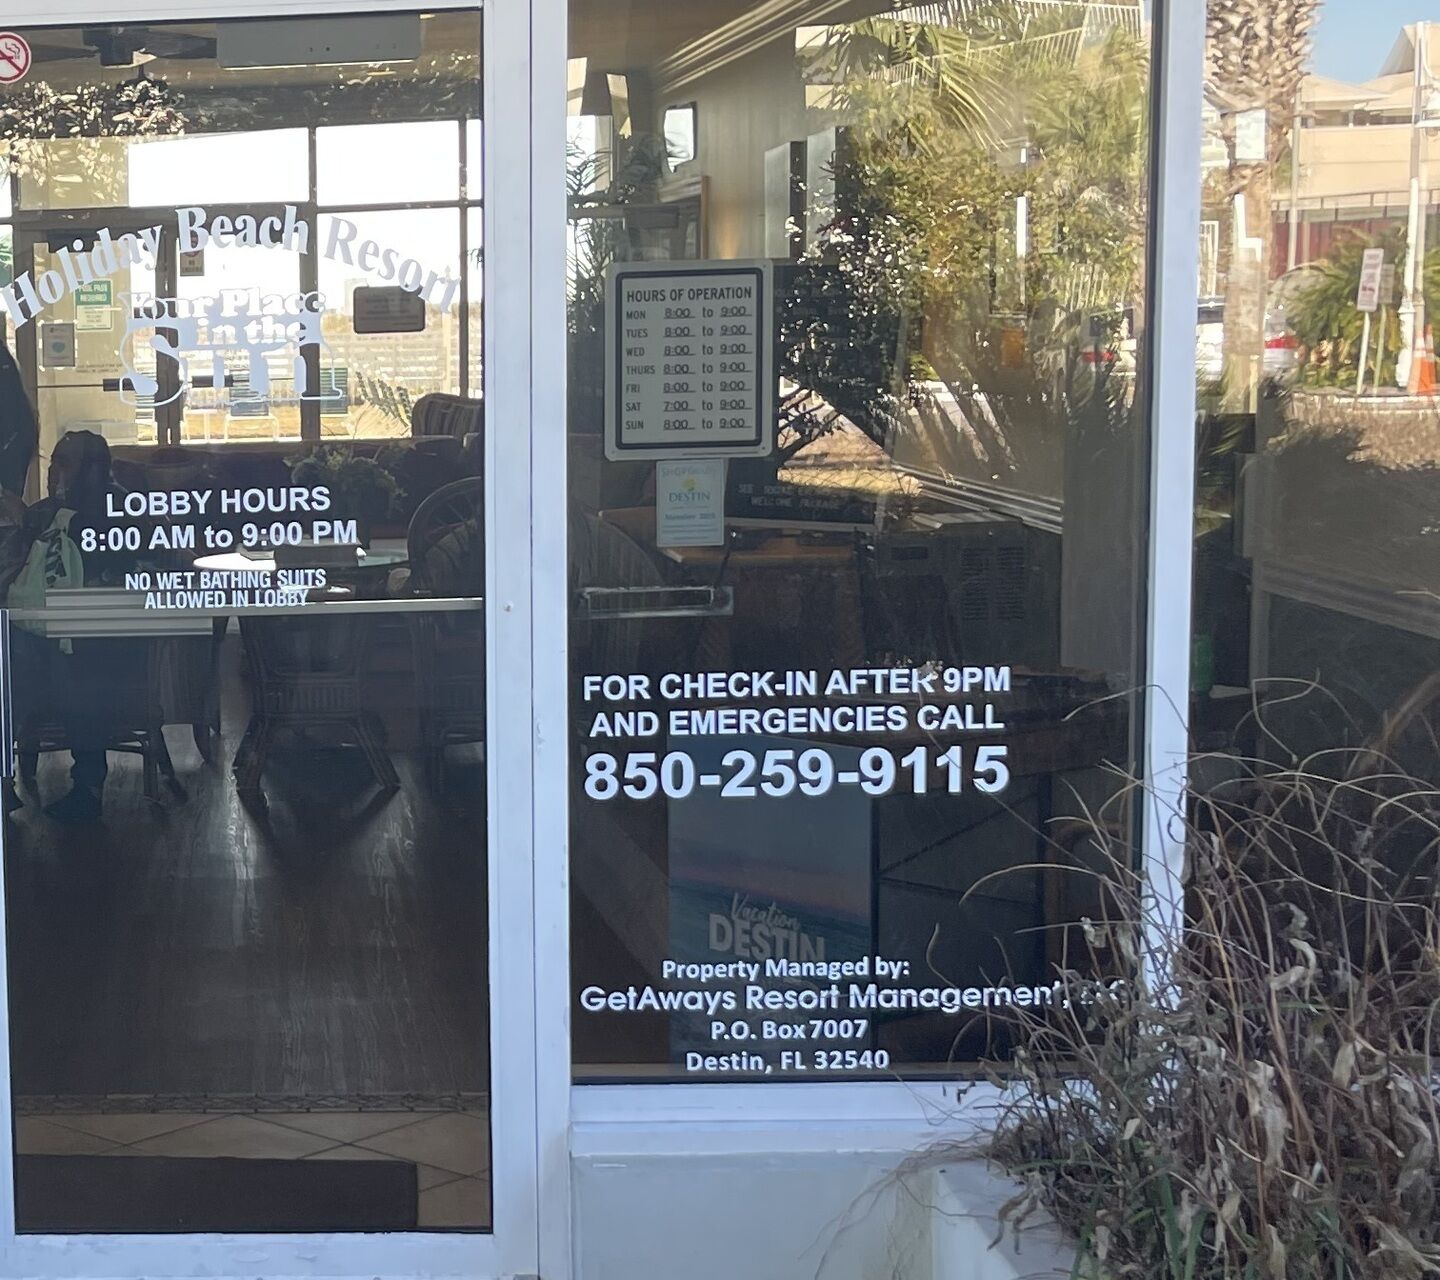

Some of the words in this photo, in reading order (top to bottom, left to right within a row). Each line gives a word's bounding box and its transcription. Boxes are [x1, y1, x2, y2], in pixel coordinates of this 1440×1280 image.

[0, 224, 163, 329] Holiday
[175, 205, 308, 254] Beach
[324, 216, 461, 314] Resort
[220, 287, 326, 318] Place
[626, 288, 666, 303] HOURS
[669, 287, 684, 301] OF
[687, 285, 753, 300] OPERATION
[626, 309, 646, 320] MON
[702, 307, 714, 319] to
[719, 306, 746, 317] 9:00
[626, 328, 648, 338] TUES
[702, 326, 714, 337] to
[719, 324, 746, 336] 9:00
[626, 346, 645, 357] WED
[702, 344, 714, 355] to
[719, 343, 746, 354] 9:00
[626, 364, 656, 375] THURS
[702, 363, 714, 374] to
[719, 362, 746, 372] 9:00
[625, 383, 640, 393] FRI
[702, 381, 714, 392] to
[719, 380, 746, 391] 9:00
[625, 401, 641, 412] SAT
[702, 400, 714, 411] to
[719, 399, 746, 410] 9:00
[625, 420, 645, 430] SUN
[702, 418, 714, 430] to
[719, 418, 746, 428] 9:00
[106, 490, 212, 518] LOBBY
[221, 486, 331, 513] HOURS
[668, 491, 711, 502] DESTIN
[81, 526, 141, 552] 8:00
[149, 524, 195, 550] AM
[205, 525, 233, 549] to
[242, 521, 303, 547] 9:00
[313, 519, 358, 545] PM
[125, 572, 150, 591] NO
[157, 572, 194, 590] WET
[200, 570, 271, 590] BATHING
[277, 568, 327, 589] SUITS
[145, 589, 226, 610] ALLOWED
[232, 589, 249, 608] IN
[255, 588, 309, 608] LOBBY
[583, 674, 650, 700] FOR
[659, 669, 817, 699] CHECK-IN
[825, 667, 936, 695] AFTER
[942, 666, 1010, 692] 9PM
[589, 710, 659, 737] AND
[669, 705, 906, 736] EMERGENCIES
[918, 704, 1005, 730] CALL
[584, 745, 1010, 800] 850-259-9115
[731, 892, 801, 930] Vacation
[709, 913, 826, 962] DESTIN
[662, 959, 759, 982] Property
[765, 957, 868, 980] Managed
[875, 956, 910, 979] by:
[580, 985, 736, 1015] GetAways
[746, 983, 838, 1011] Resort
[848, 980, 1070, 1013] Managemen,
[711, 1021, 758, 1040] P.O.
[763, 1020, 806, 1039] Box
[809, 1019, 868, 1038] 7007
[686, 1051, 772, 1074] Destin,
[781, 1051, 807, 1070] FL
[814, 1050, 890, 1069] 32540
